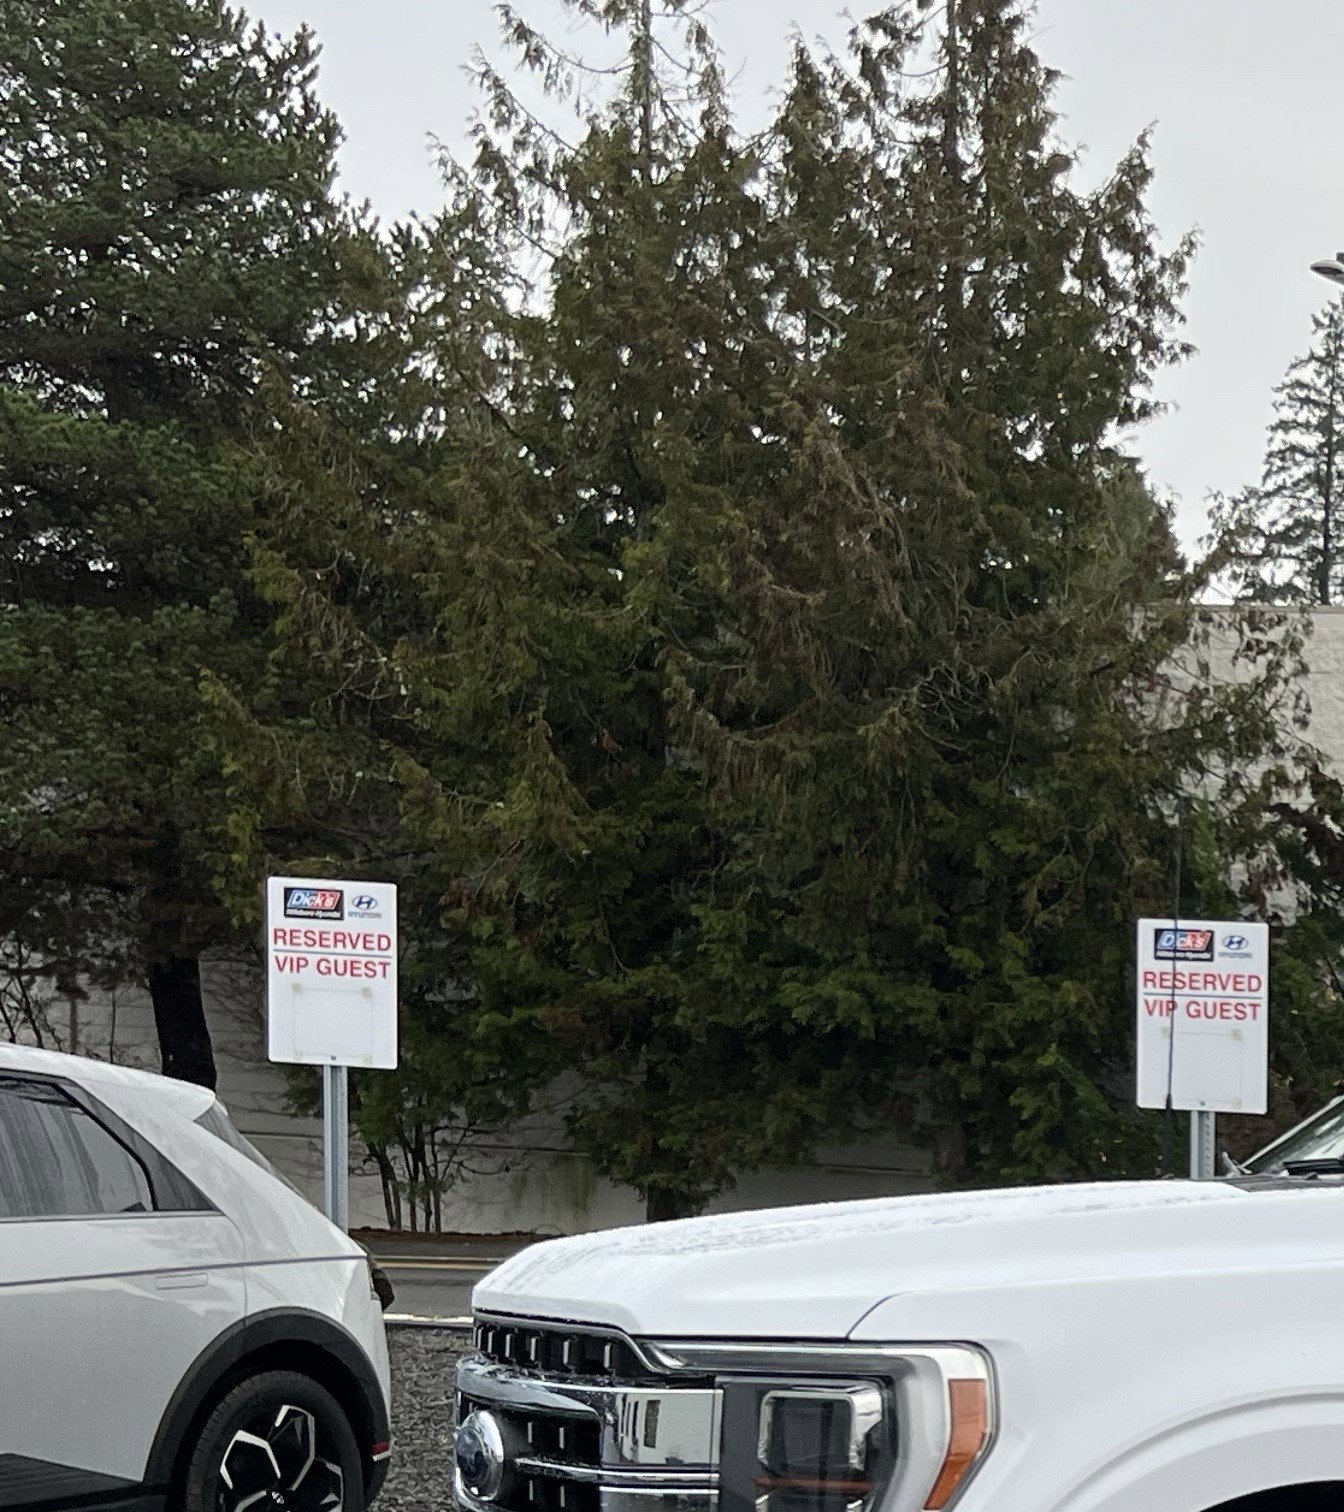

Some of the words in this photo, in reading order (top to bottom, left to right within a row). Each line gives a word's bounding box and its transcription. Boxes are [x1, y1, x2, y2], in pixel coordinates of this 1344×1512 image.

[273, 927, 391, 951] RESERVED
[275, 955, 309, 974] VIP
[316, 957, 391, 979] GUEST
[1143, 970, 1262, 993] RESERVED
[1144, 998, 1178, 1018] VIP
[1186, 1000, 1261, 1021] GUEST
